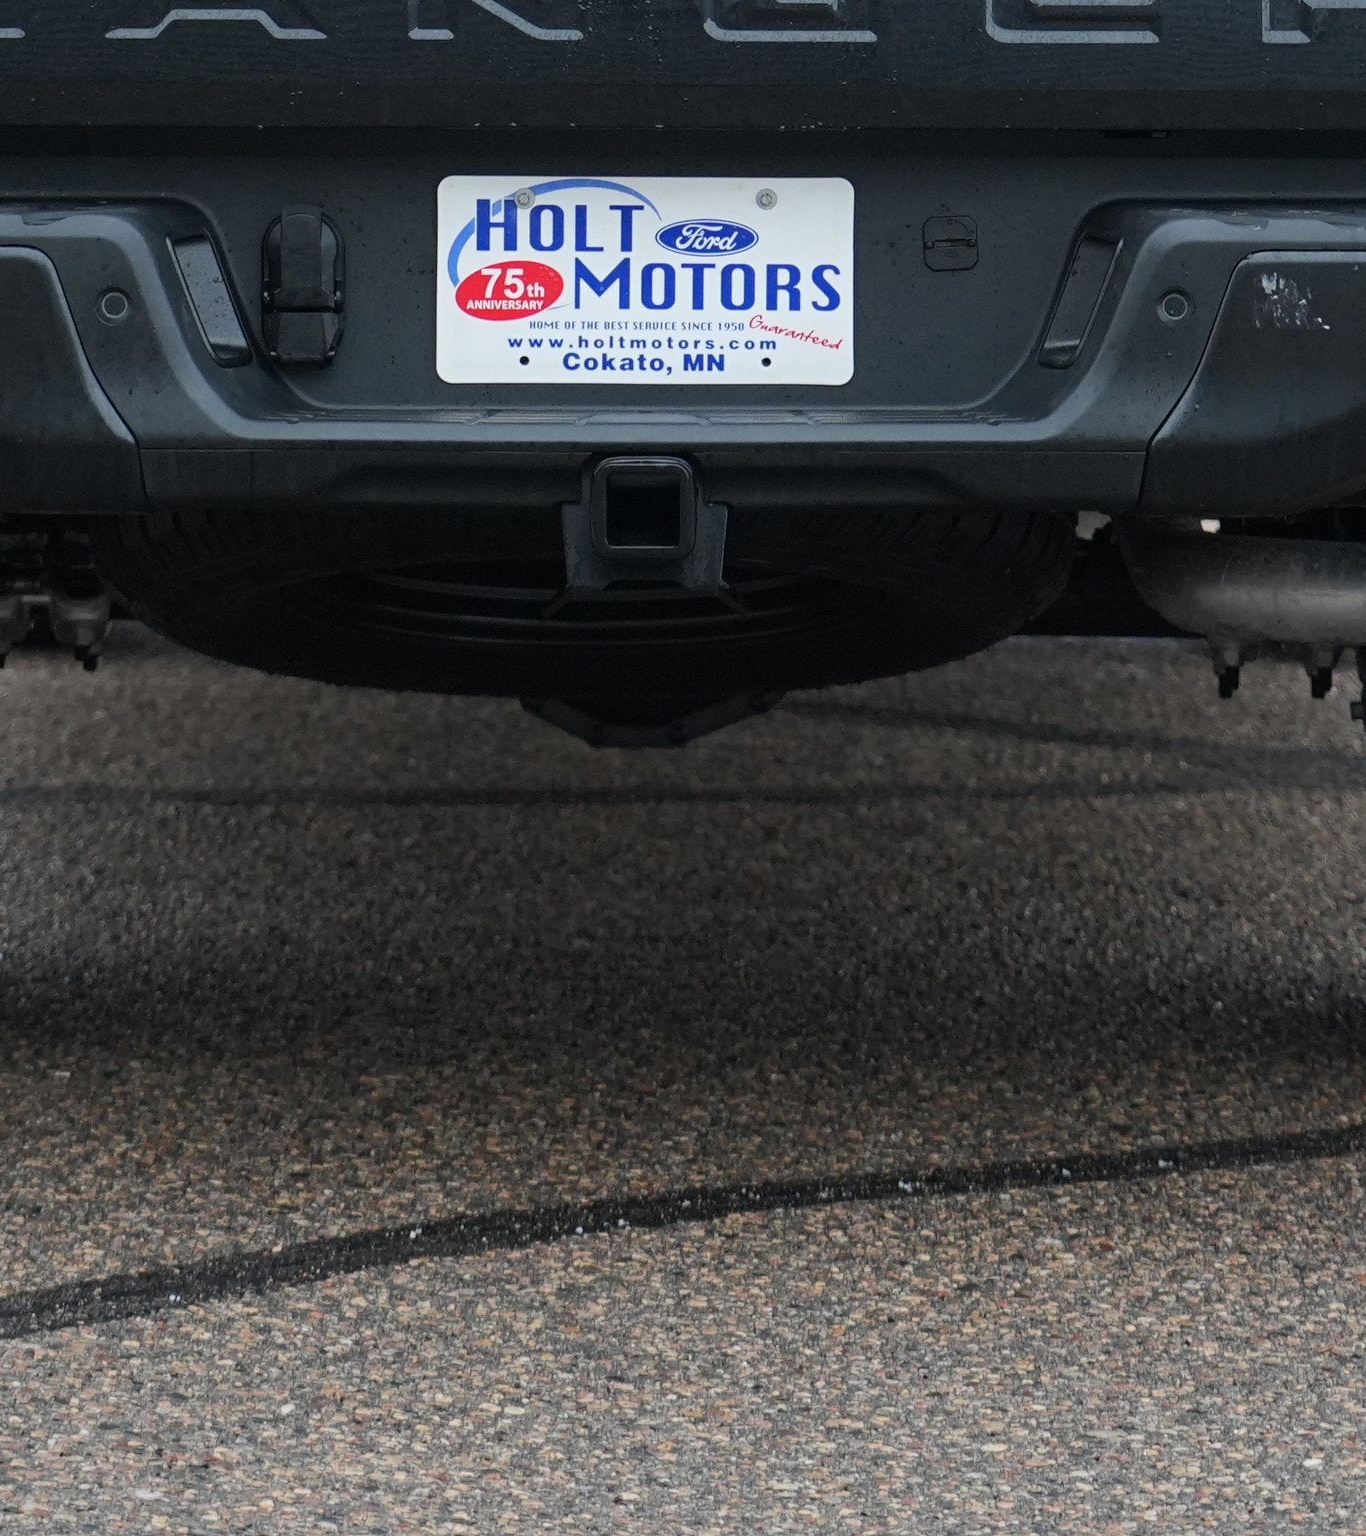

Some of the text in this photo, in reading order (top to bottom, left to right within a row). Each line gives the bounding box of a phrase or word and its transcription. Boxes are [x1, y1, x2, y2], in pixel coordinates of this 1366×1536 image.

[476, 198, 645, 252] HOLT
[675, 223, 739, 251] Ford
[480, 267, 546, 300] 75th
[574, 257, 842, 312] MOTORS
[466, 299, 545, 311] ANNIVERSARY
[529, 320, 745, 332] HOME OF THE BEST SERVICE SINCE 1950
[749, 314, 843, 351] Guaranteed
[508, 336, 777, 350] www.holtmotors.com
[562, 352, 726, 376] Cokato, MN
